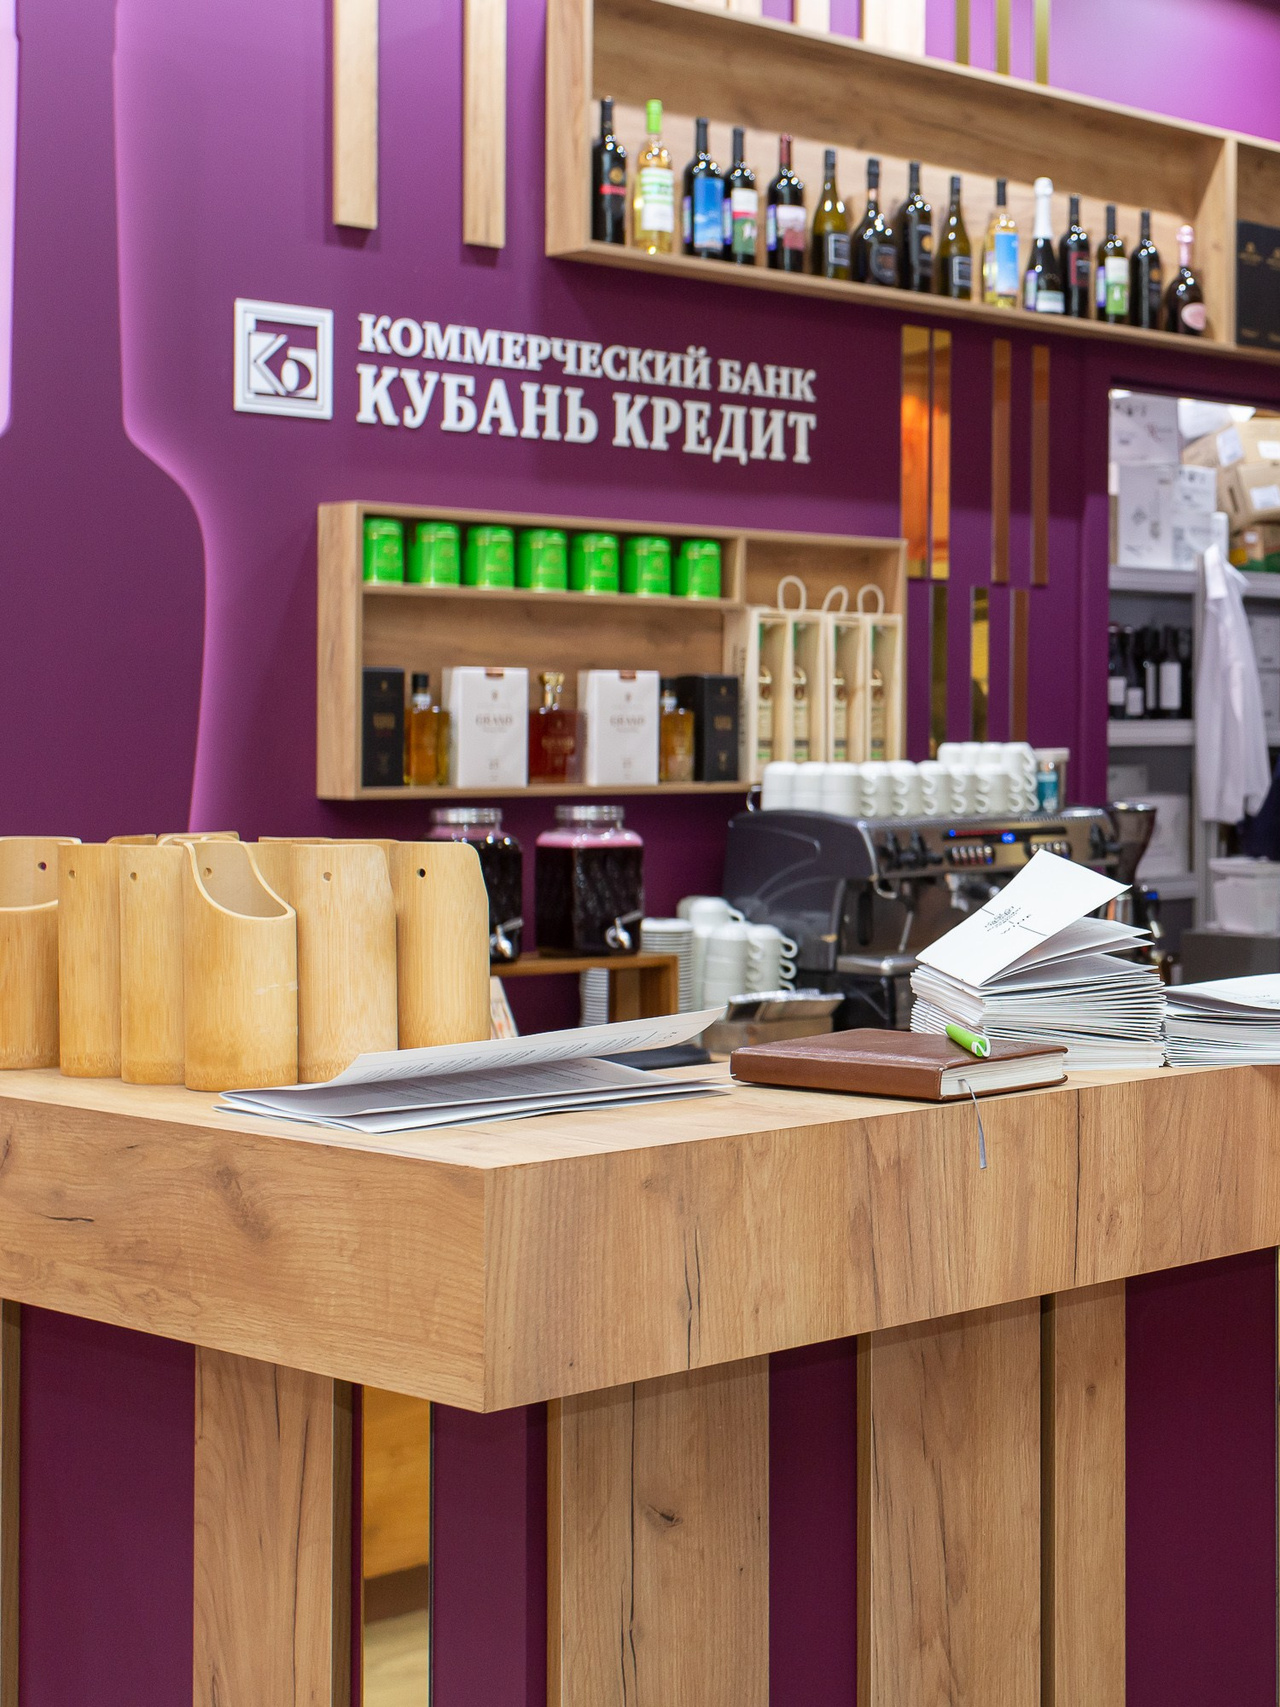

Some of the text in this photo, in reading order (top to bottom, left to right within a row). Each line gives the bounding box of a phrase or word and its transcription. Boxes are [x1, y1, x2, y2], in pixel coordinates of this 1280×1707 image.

[356, 312, 817, 402] КОММЕРЧЕСКИЙ БАНК
[355, 363, 817, 466] КУБАНЬ КРЕДИТ
